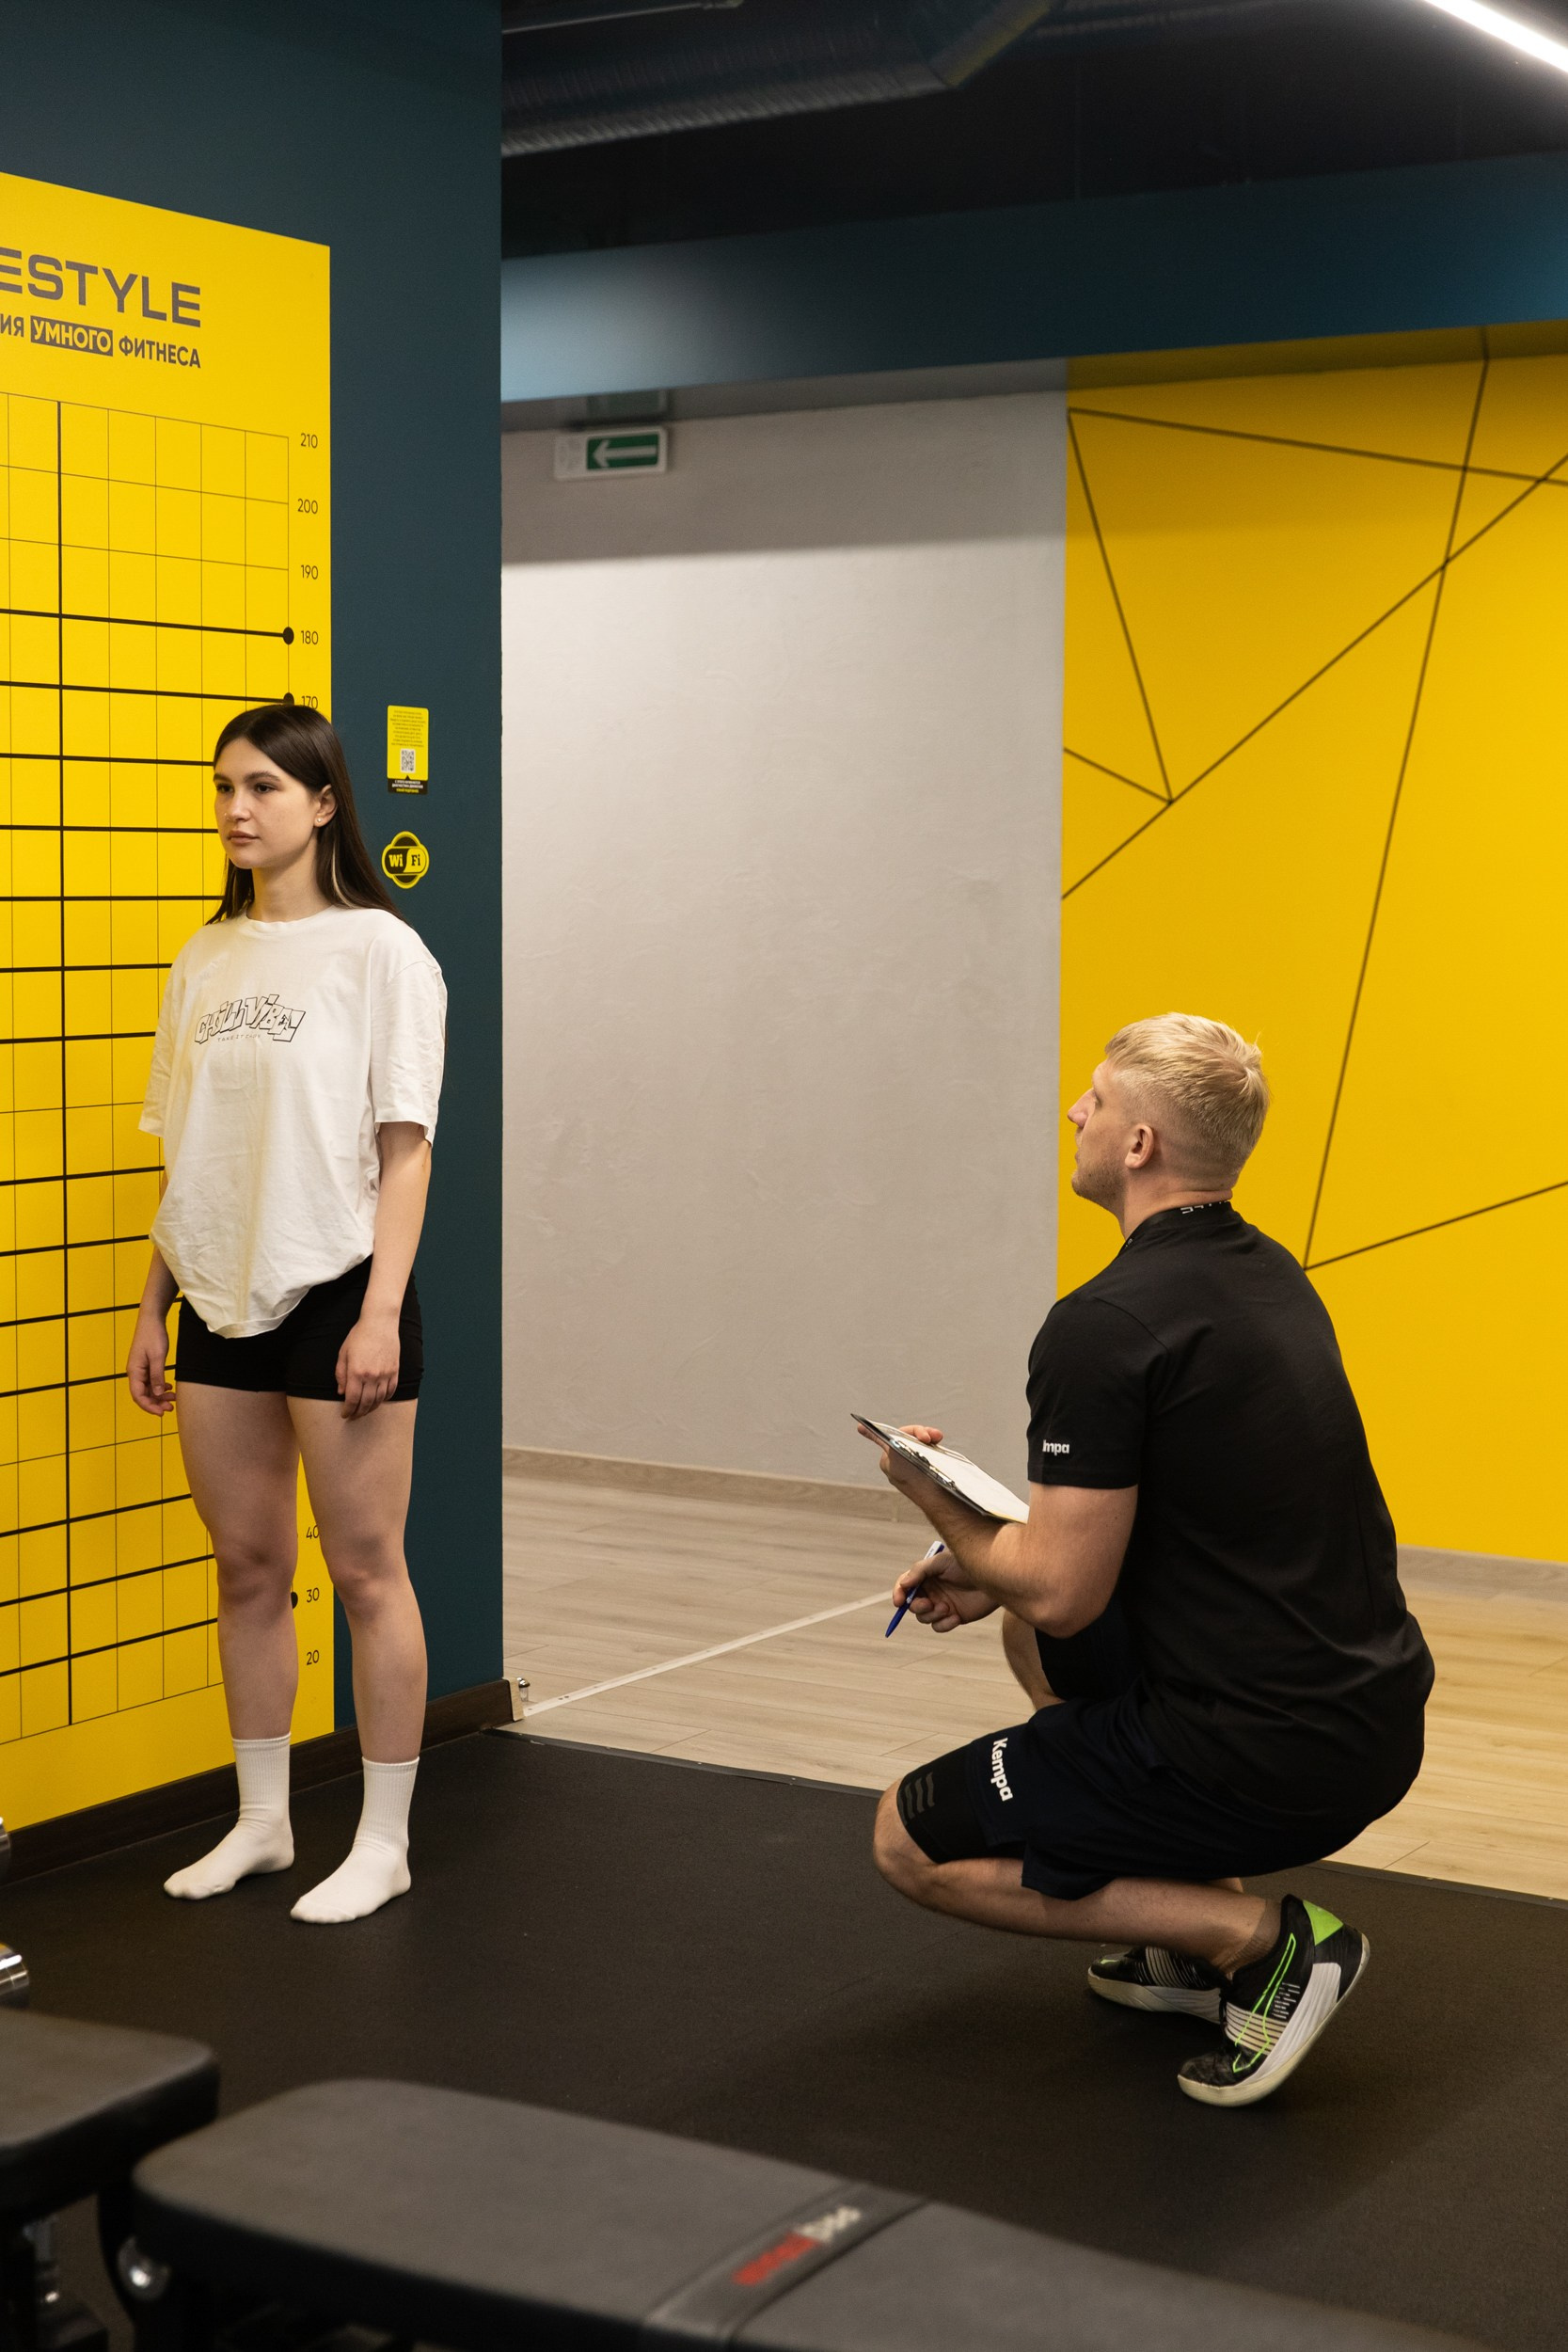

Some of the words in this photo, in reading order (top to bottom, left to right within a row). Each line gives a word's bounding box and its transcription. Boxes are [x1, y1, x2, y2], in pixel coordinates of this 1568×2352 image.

[32, 318, 112, 354] УМНОГО
[119, 335, 201, 369] ФИТНЕСА
[300, 433, 319, 449] 210
[297, 498, 319, 515] 200
[300, 564, 319, 580] 190
[300, 630, 319, 645] 180
[301, 695, 319, 709] 170
[388, 853, 404, 867] Wi
[411, 854, 420, 866] Fi
[306, 1524, 319, 1540] 40
[306, 1587, 320, 1603] 30
[306, 1649, 320, 1665] 20
[990, 1737, 1014, 1802] Kempa
